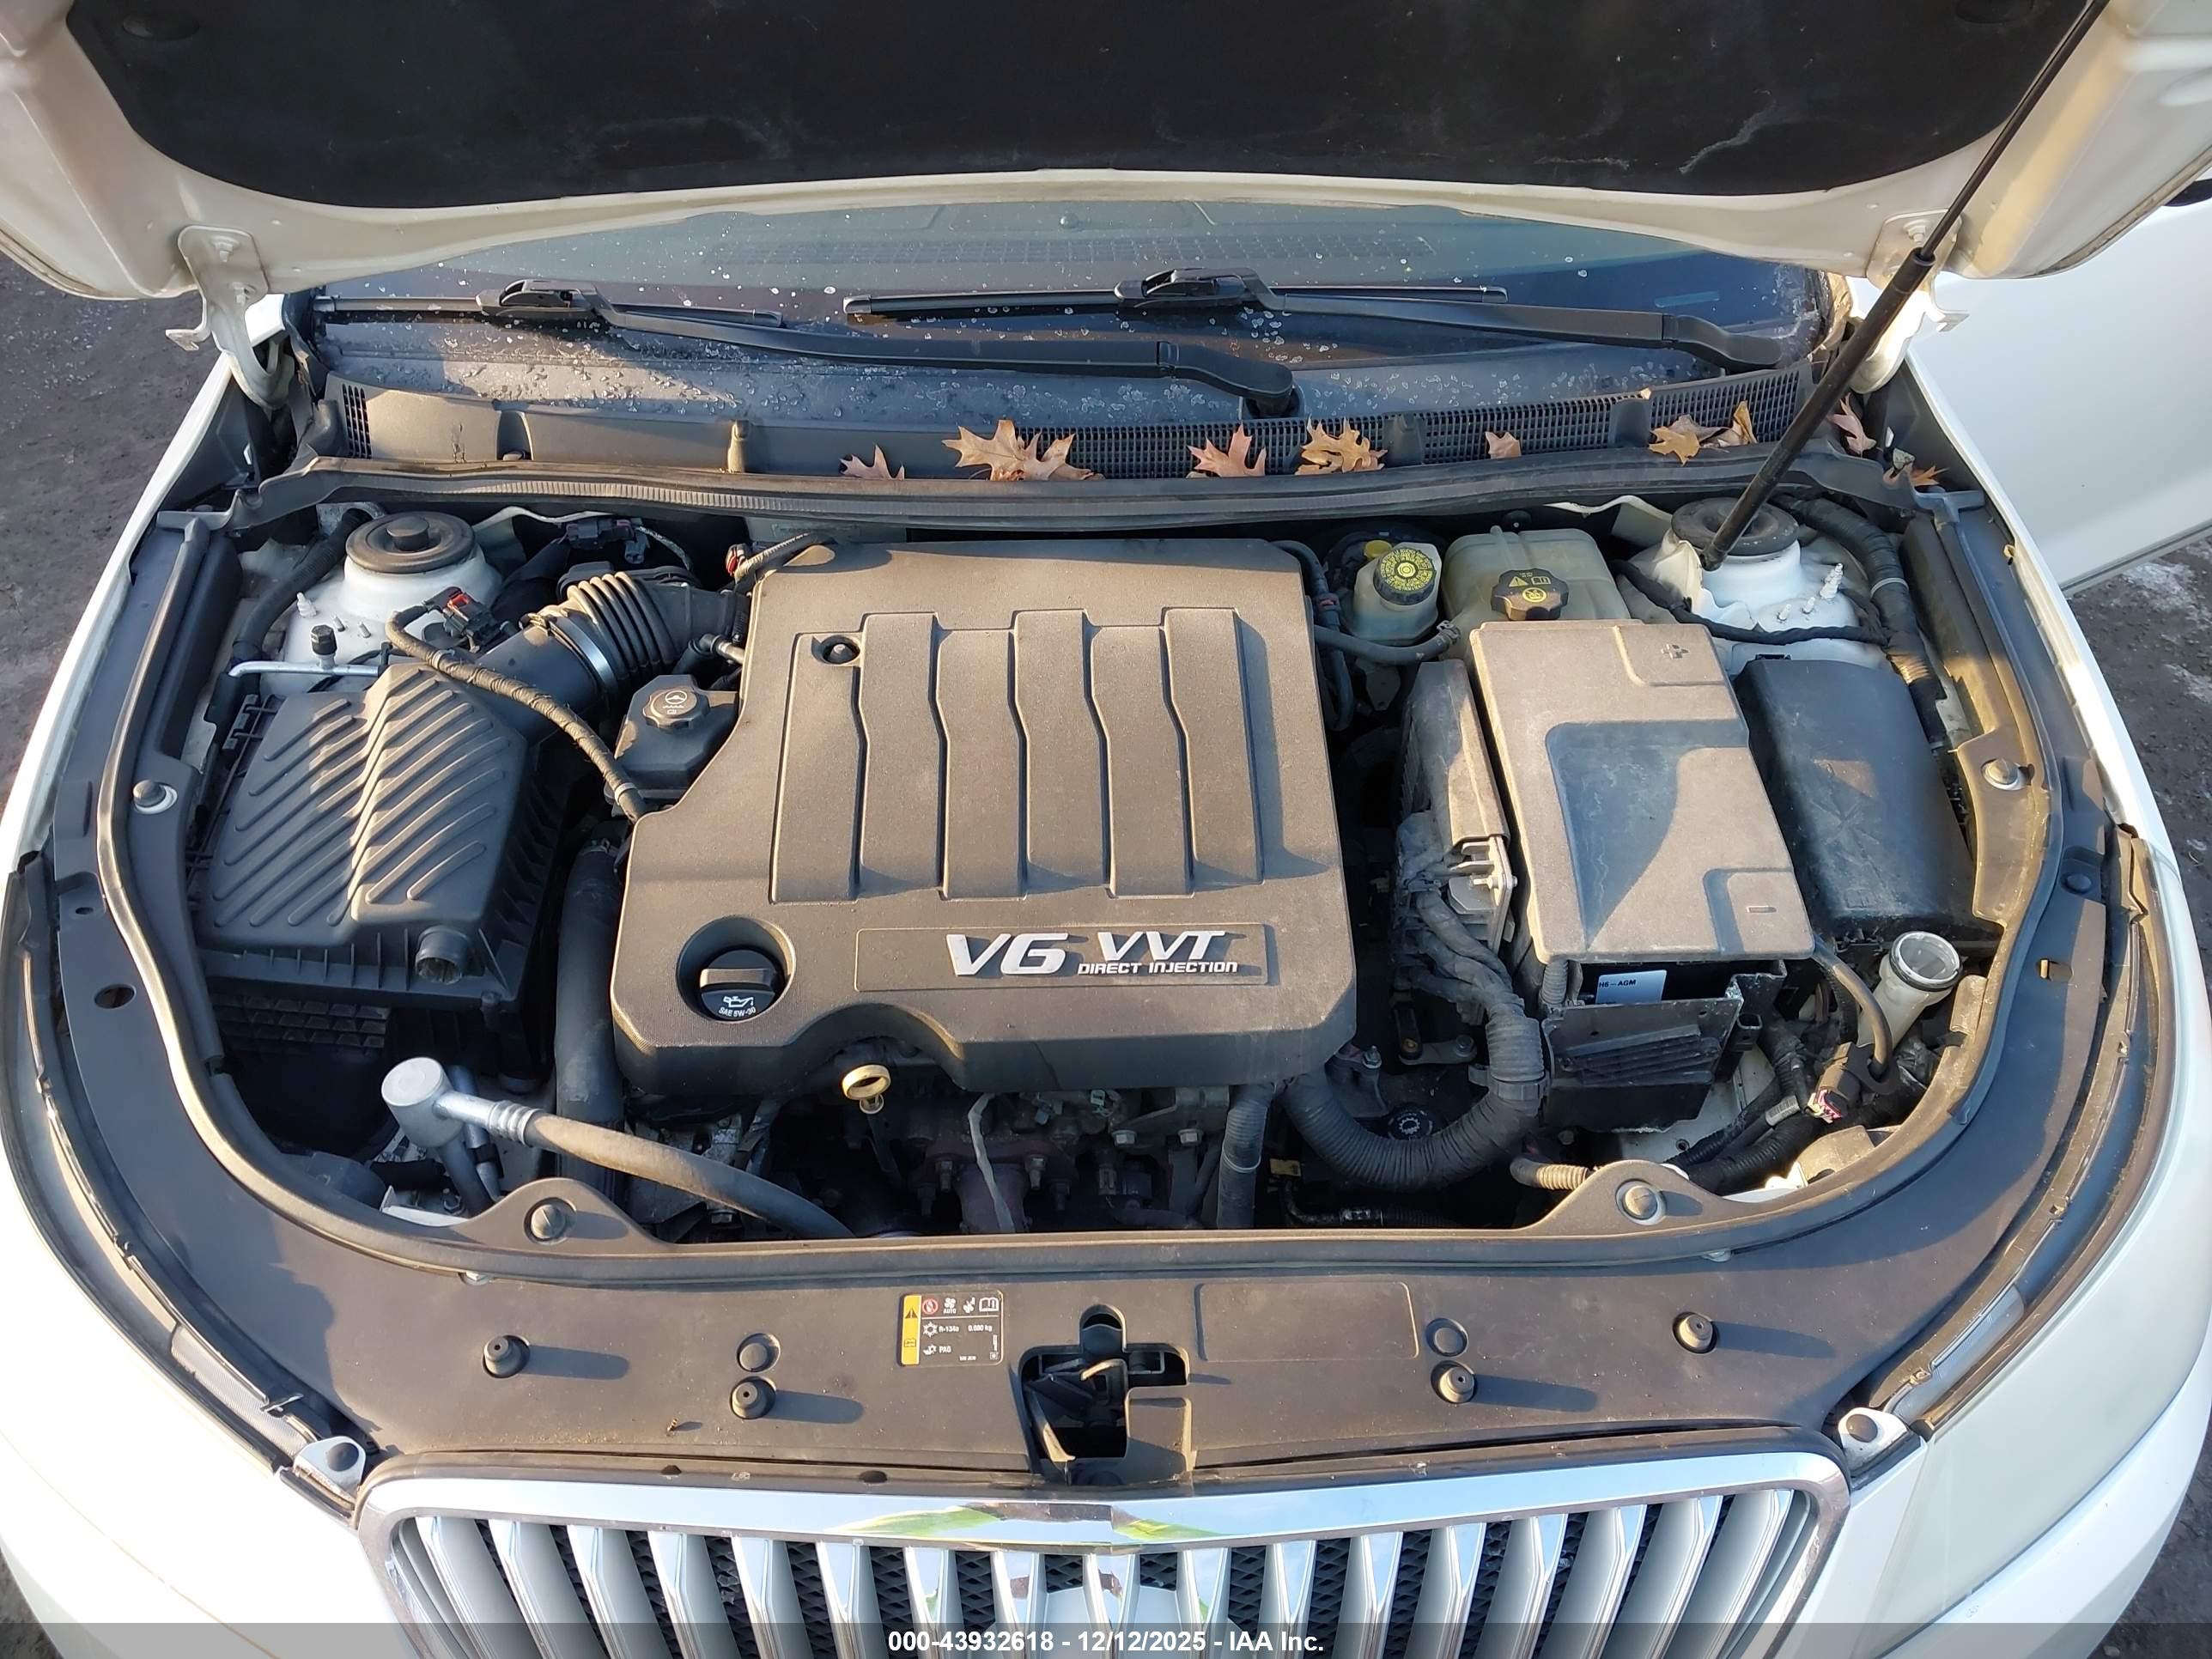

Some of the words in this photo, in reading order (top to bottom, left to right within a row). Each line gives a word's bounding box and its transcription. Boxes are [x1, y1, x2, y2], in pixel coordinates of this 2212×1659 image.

[946, 933, 1068, 975] V6
[1097, 931, 1225, 961] VVT
[1078, 963, 1143, 975] DIRECT
[1149, 962, 1237, 974] INJECTION
[718, 1006, 732, 1017] SAE
[733, 1006, 757, 1018] 5W-30
